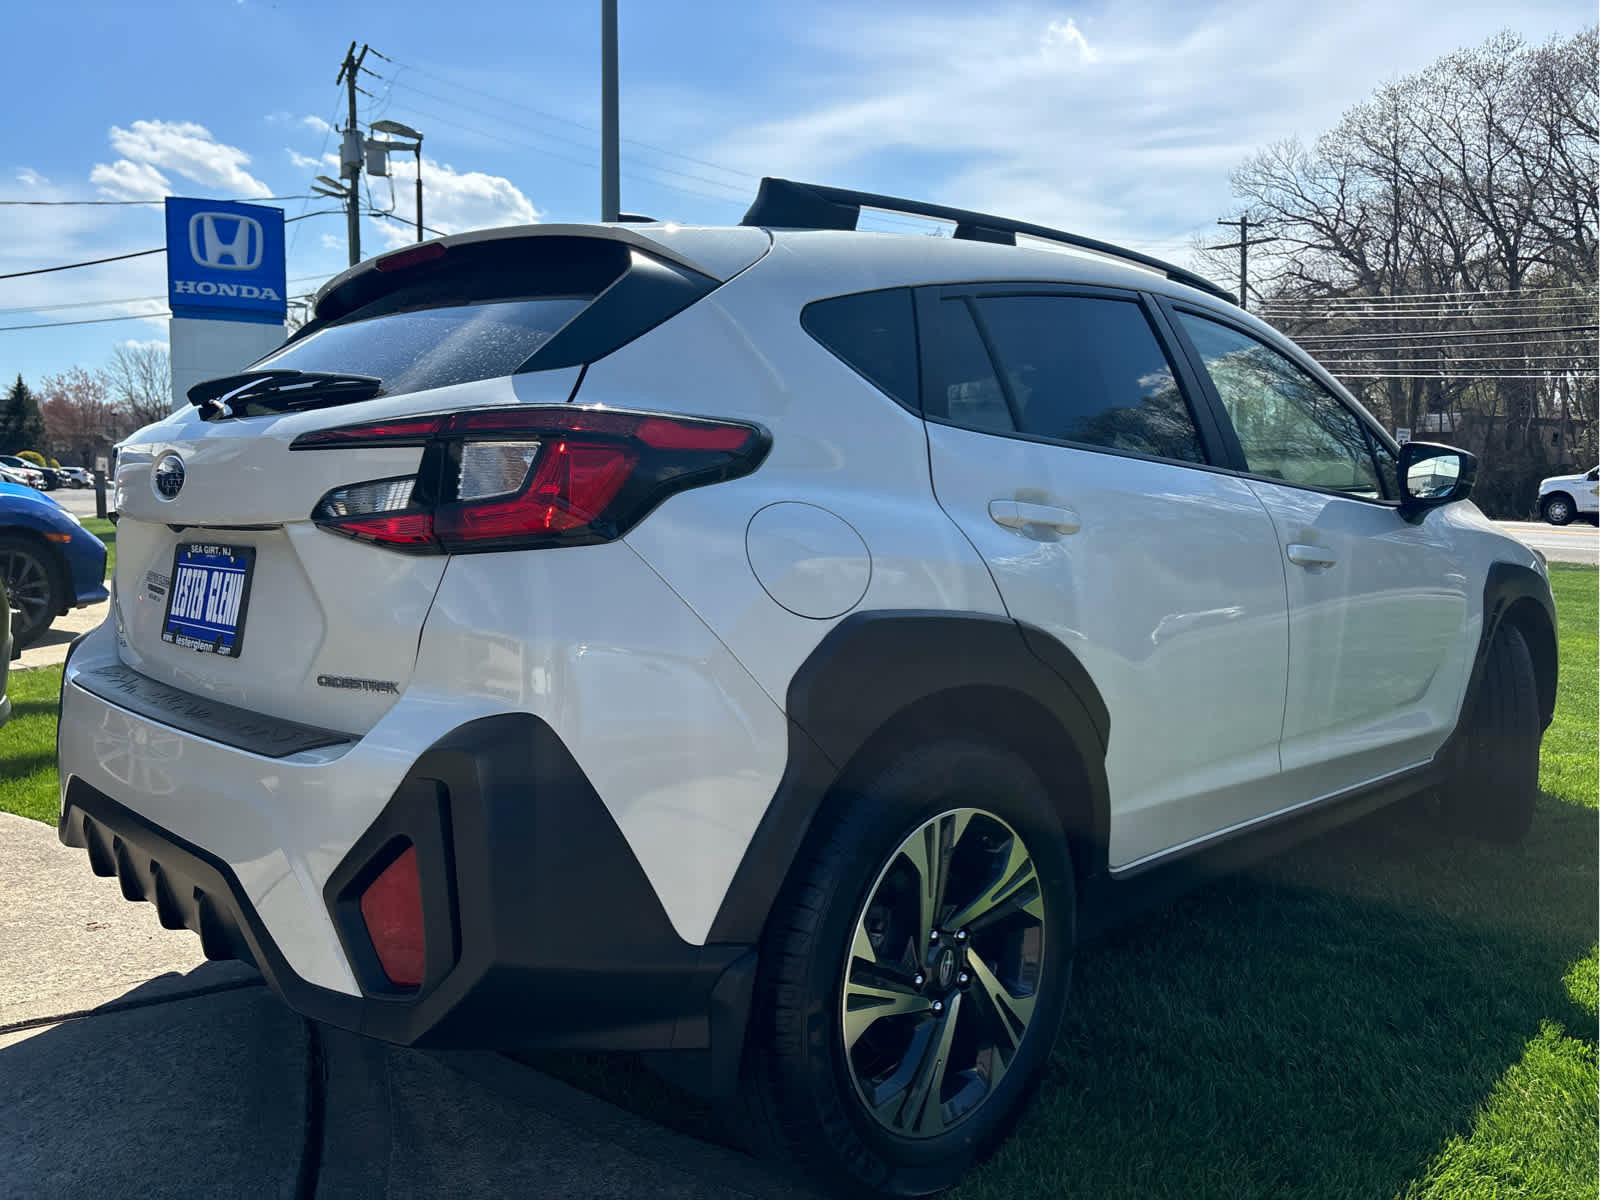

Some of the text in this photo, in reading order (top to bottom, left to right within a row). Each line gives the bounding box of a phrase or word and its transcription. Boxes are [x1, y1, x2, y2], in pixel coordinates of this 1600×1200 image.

[174, 280, 281, 301] HONDA
[191, 544, 203, 554] SEA
[222, 547, 231, 556] NJ
[171, 567, 245, 627] LESTER GLENN
[316, 674, 400, 695] CROSSTREK
